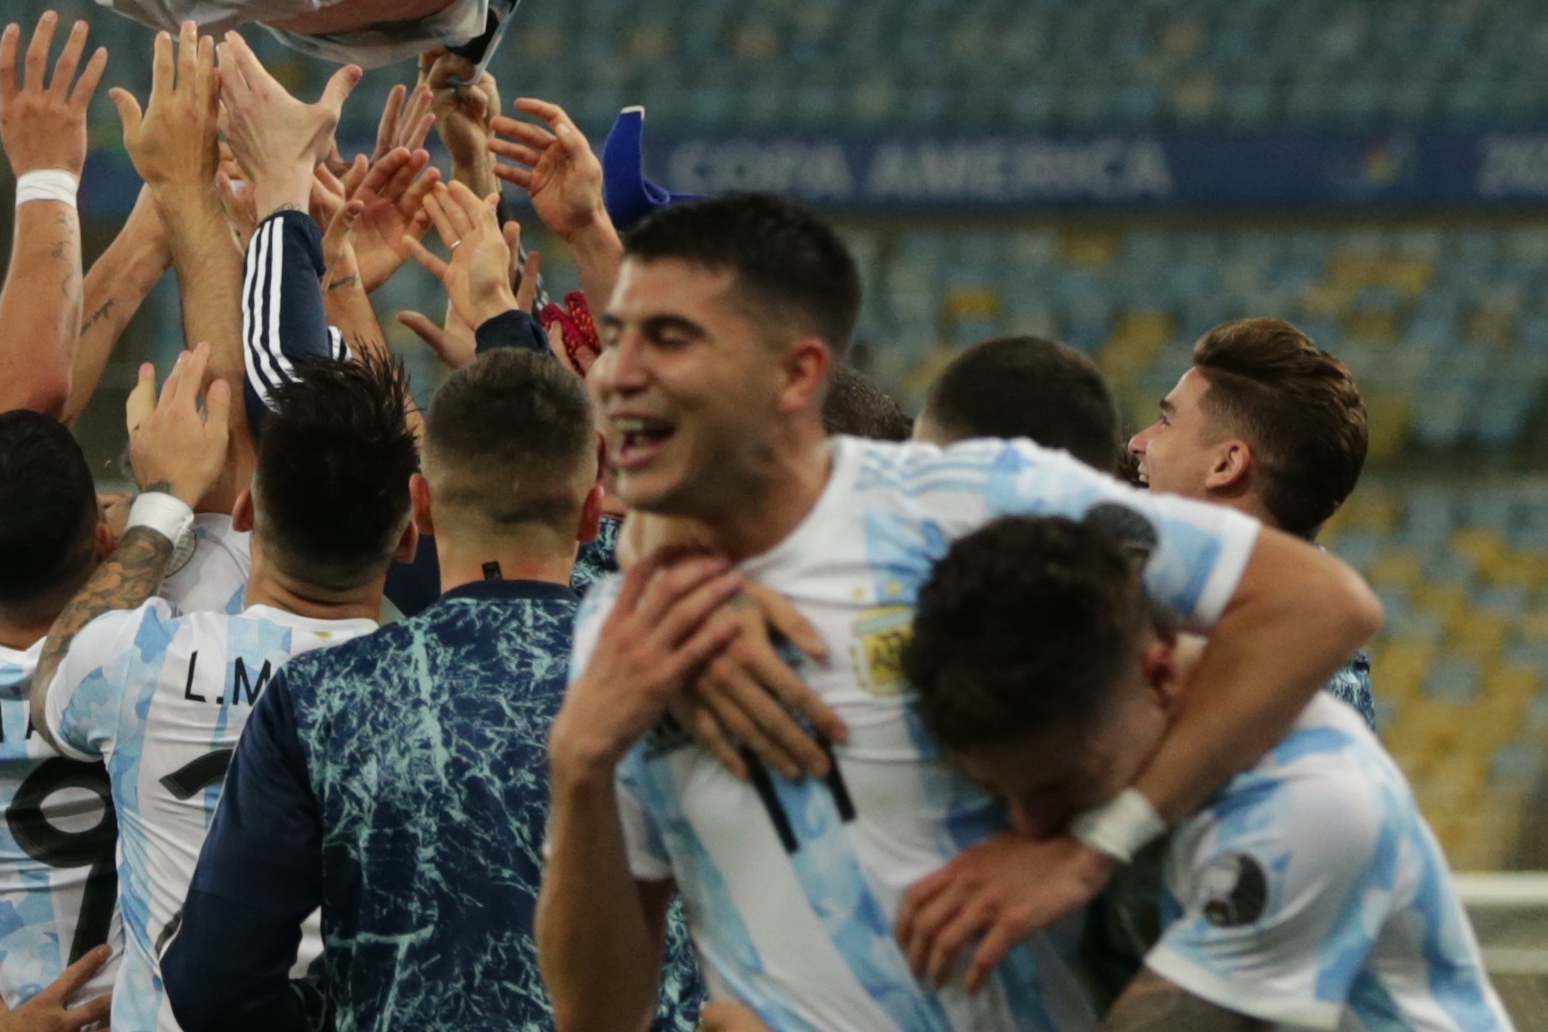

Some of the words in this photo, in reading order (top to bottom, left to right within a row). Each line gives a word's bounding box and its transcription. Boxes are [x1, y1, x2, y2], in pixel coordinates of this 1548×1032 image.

[665, 138, 854, 199] COPA
[184, 650, 272, 706] L.M
[5, 756, 120, 966] 9
